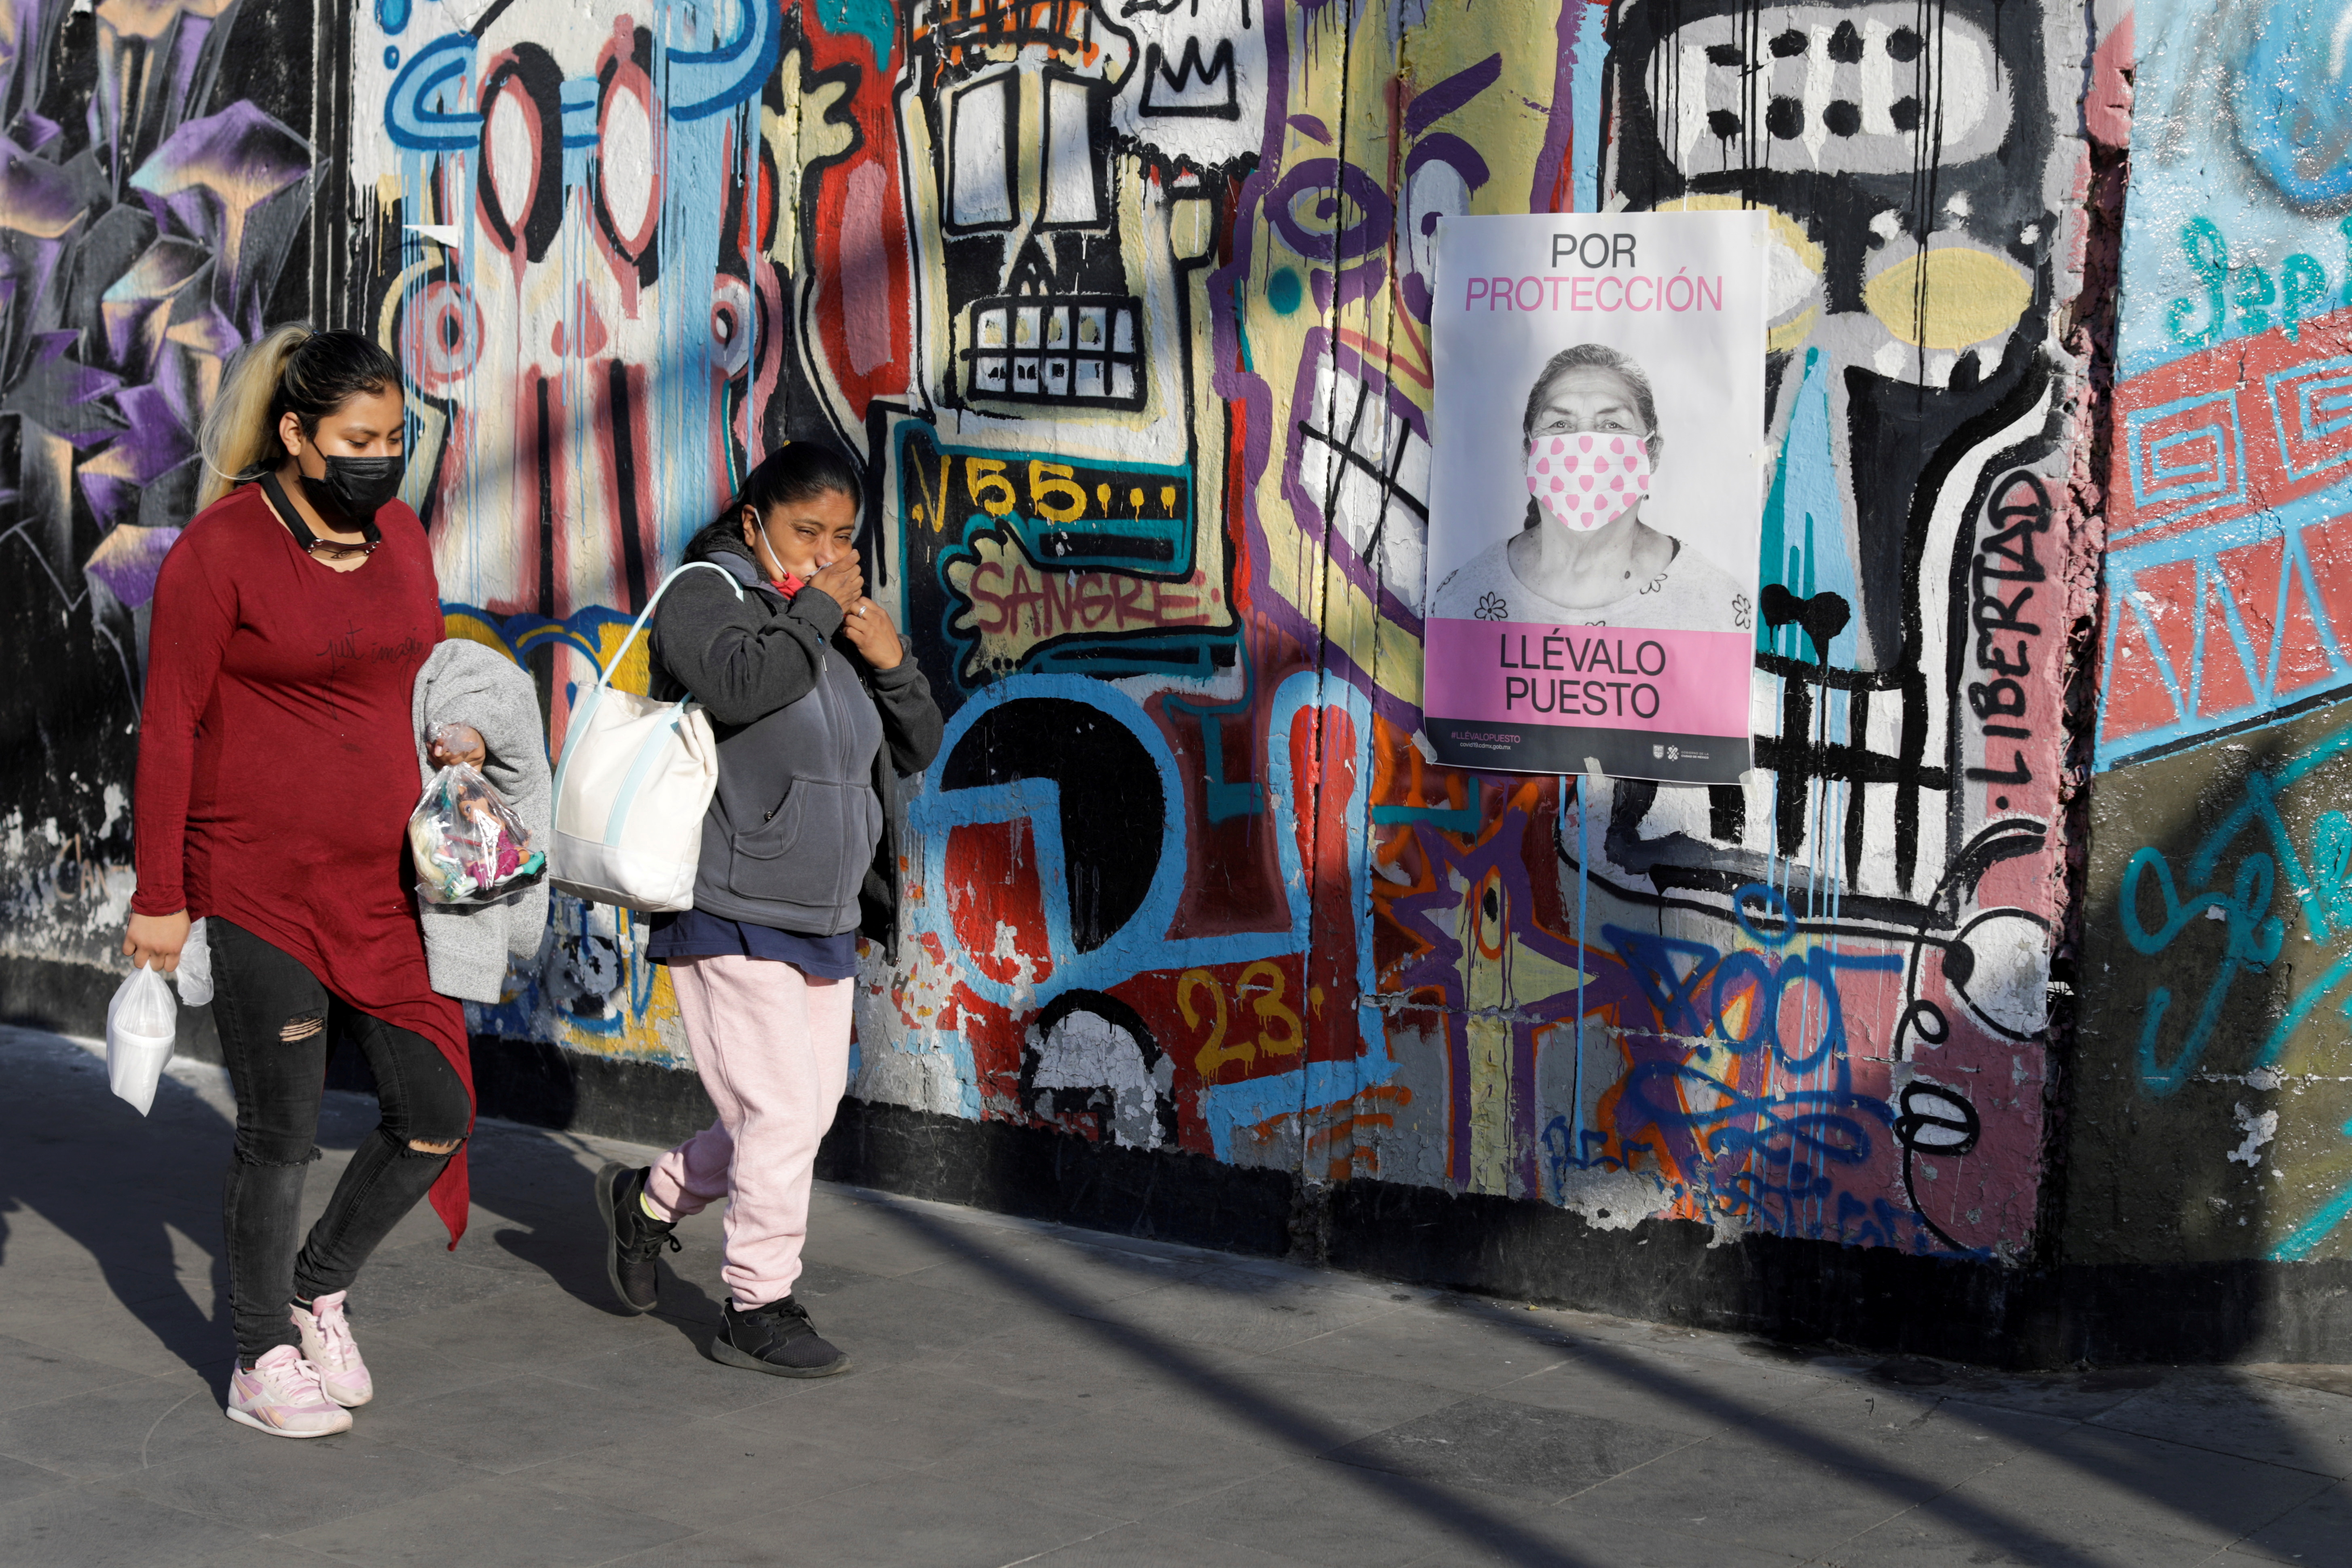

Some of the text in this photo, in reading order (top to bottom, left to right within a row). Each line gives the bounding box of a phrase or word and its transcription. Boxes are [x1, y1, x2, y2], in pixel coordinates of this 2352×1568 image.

[1552, 233, 1636, 269] POR
[1465, 266, 1723, 312] PROTECCIÓN
[971, 561, 1210, 638] SANGRE
[1965, 468, 2052, 785] LIBERTAD
[1500, 628, 1666, 676] LLÉVALO
[1505, 676, 1660, 719] PUESTO
[1451, 730, 1521, 743] #LLÉVALOPUESTO
[1459, 742, 1511, 750] covid19.cdmx.gob.mx
[1177, 961, 1303, 1079] 23
